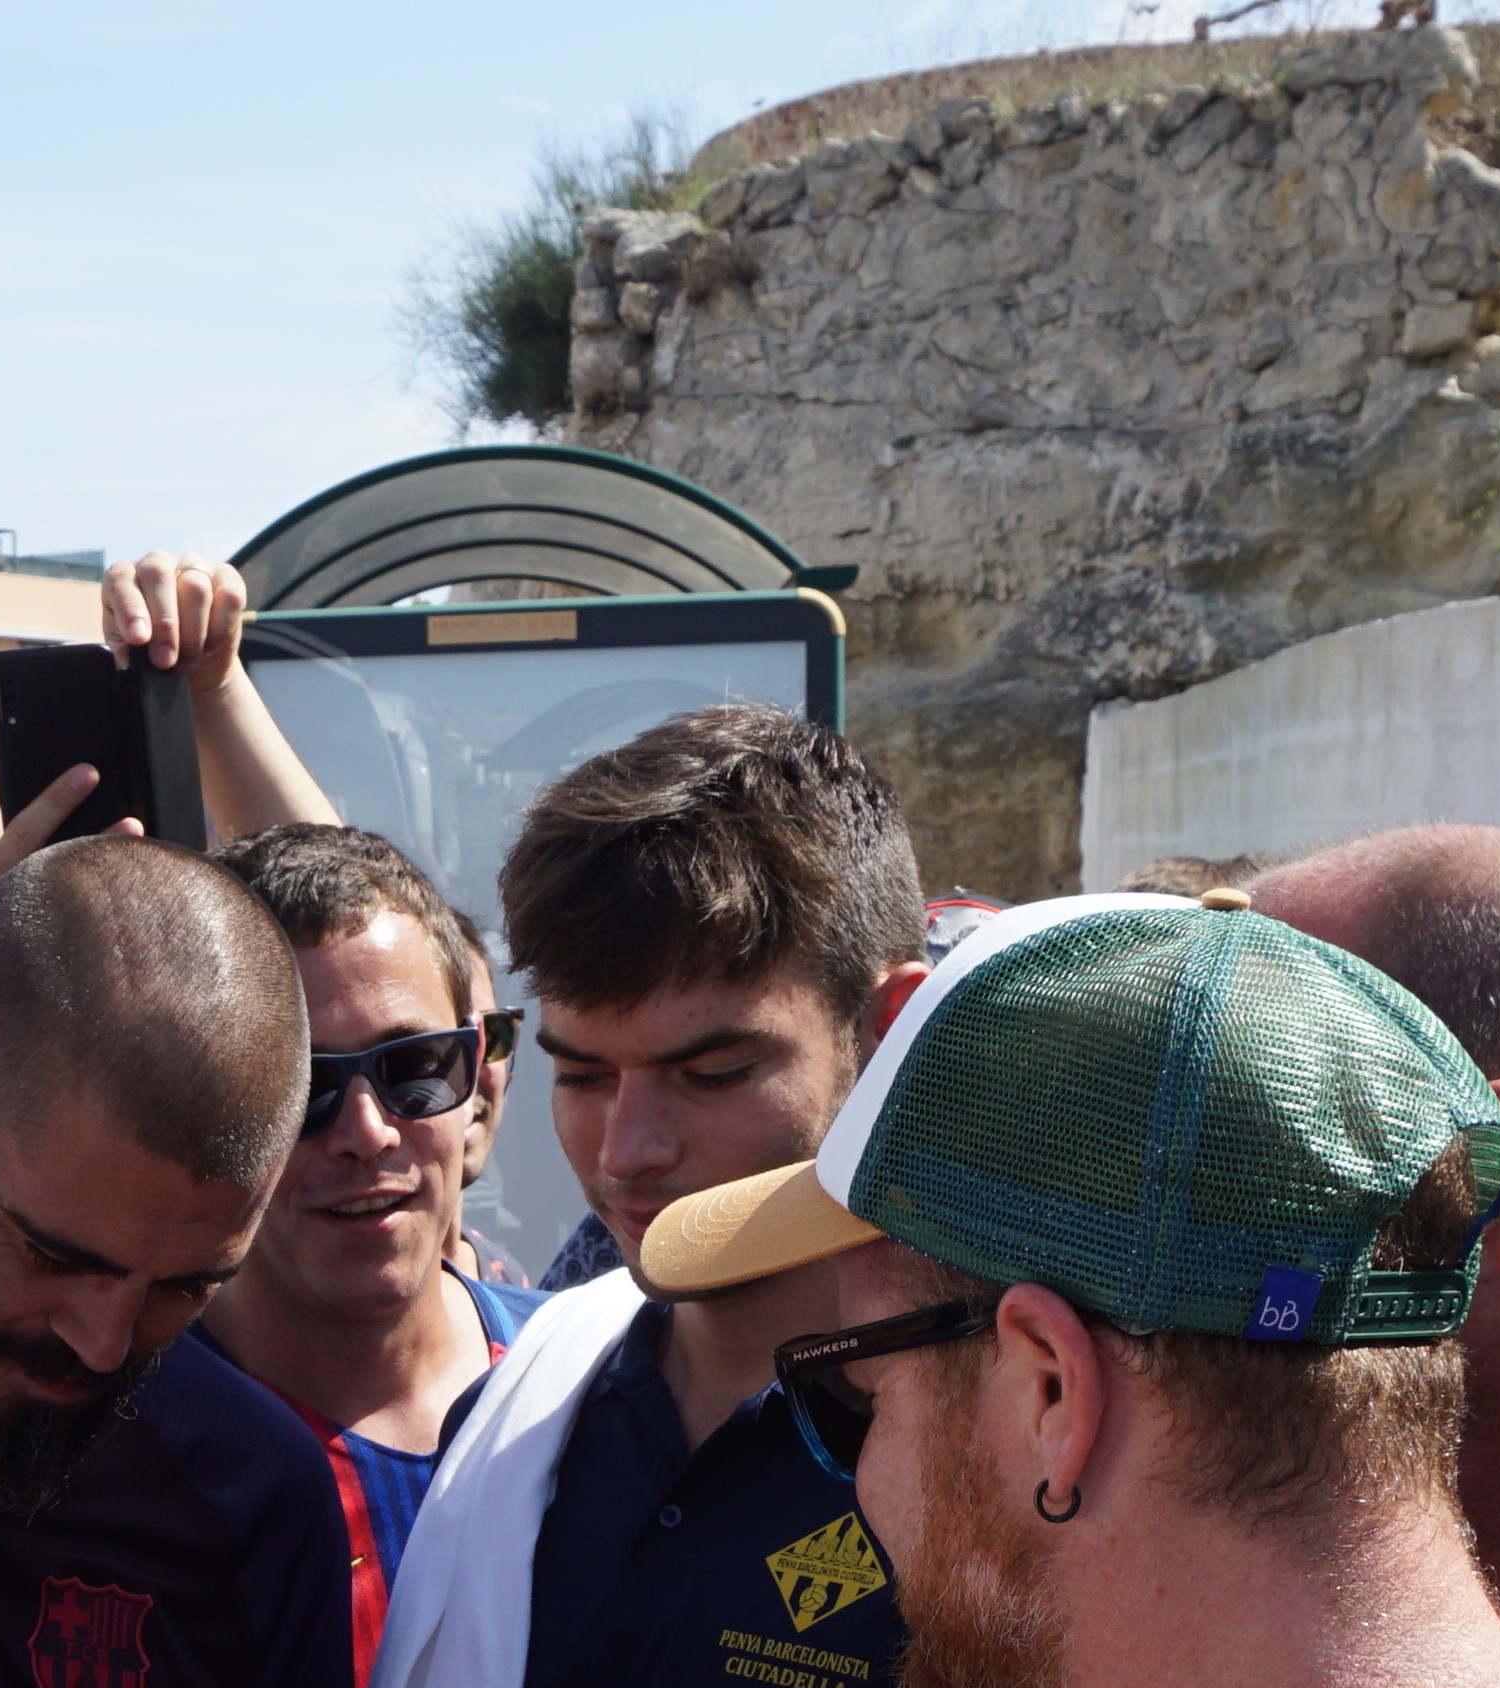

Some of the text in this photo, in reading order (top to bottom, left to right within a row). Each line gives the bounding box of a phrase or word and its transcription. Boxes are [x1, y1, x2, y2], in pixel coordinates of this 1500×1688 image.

[793, 1337, 859, 1362] HAWKERS
[777, 1557, 797, 1570] PENYA
[718, 1629, 871, 1680] PENYA BARCELONISTA
